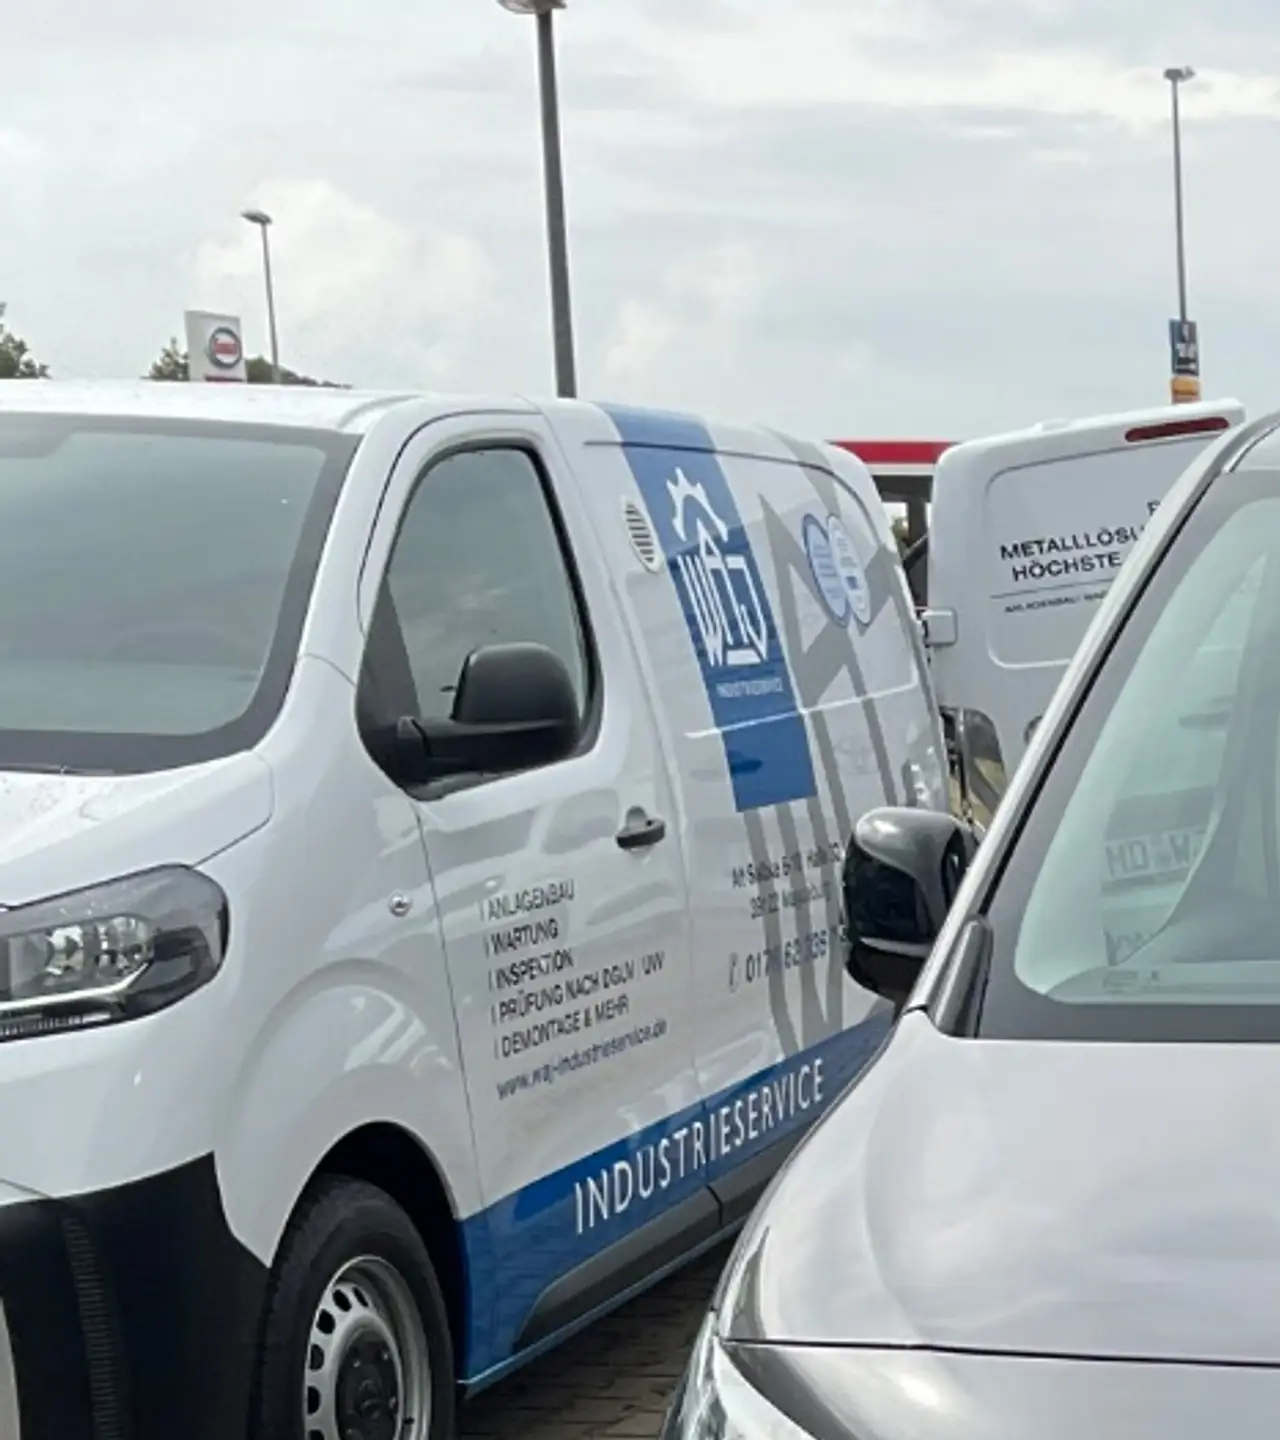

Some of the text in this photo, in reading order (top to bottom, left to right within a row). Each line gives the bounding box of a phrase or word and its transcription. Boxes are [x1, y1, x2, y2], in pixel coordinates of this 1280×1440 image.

[1012, 551, 1122, 581] HÖCHSTE
[488, 879, 575, 920] ANLAGENBAU
[491, 918, 559, 956] WARTUNG
[496, 948, 574, 990] INSPEKTION
[499, 984, 563, 1023] PRÜFUNG
[565, 971, 599, 999] NACH
[502, 1010, 581, 1058] DEMONTAGE
[595, 993, 629, 1022] MEHR
[574, 1058, 824, 1235] INDUSTRIESERVICE
